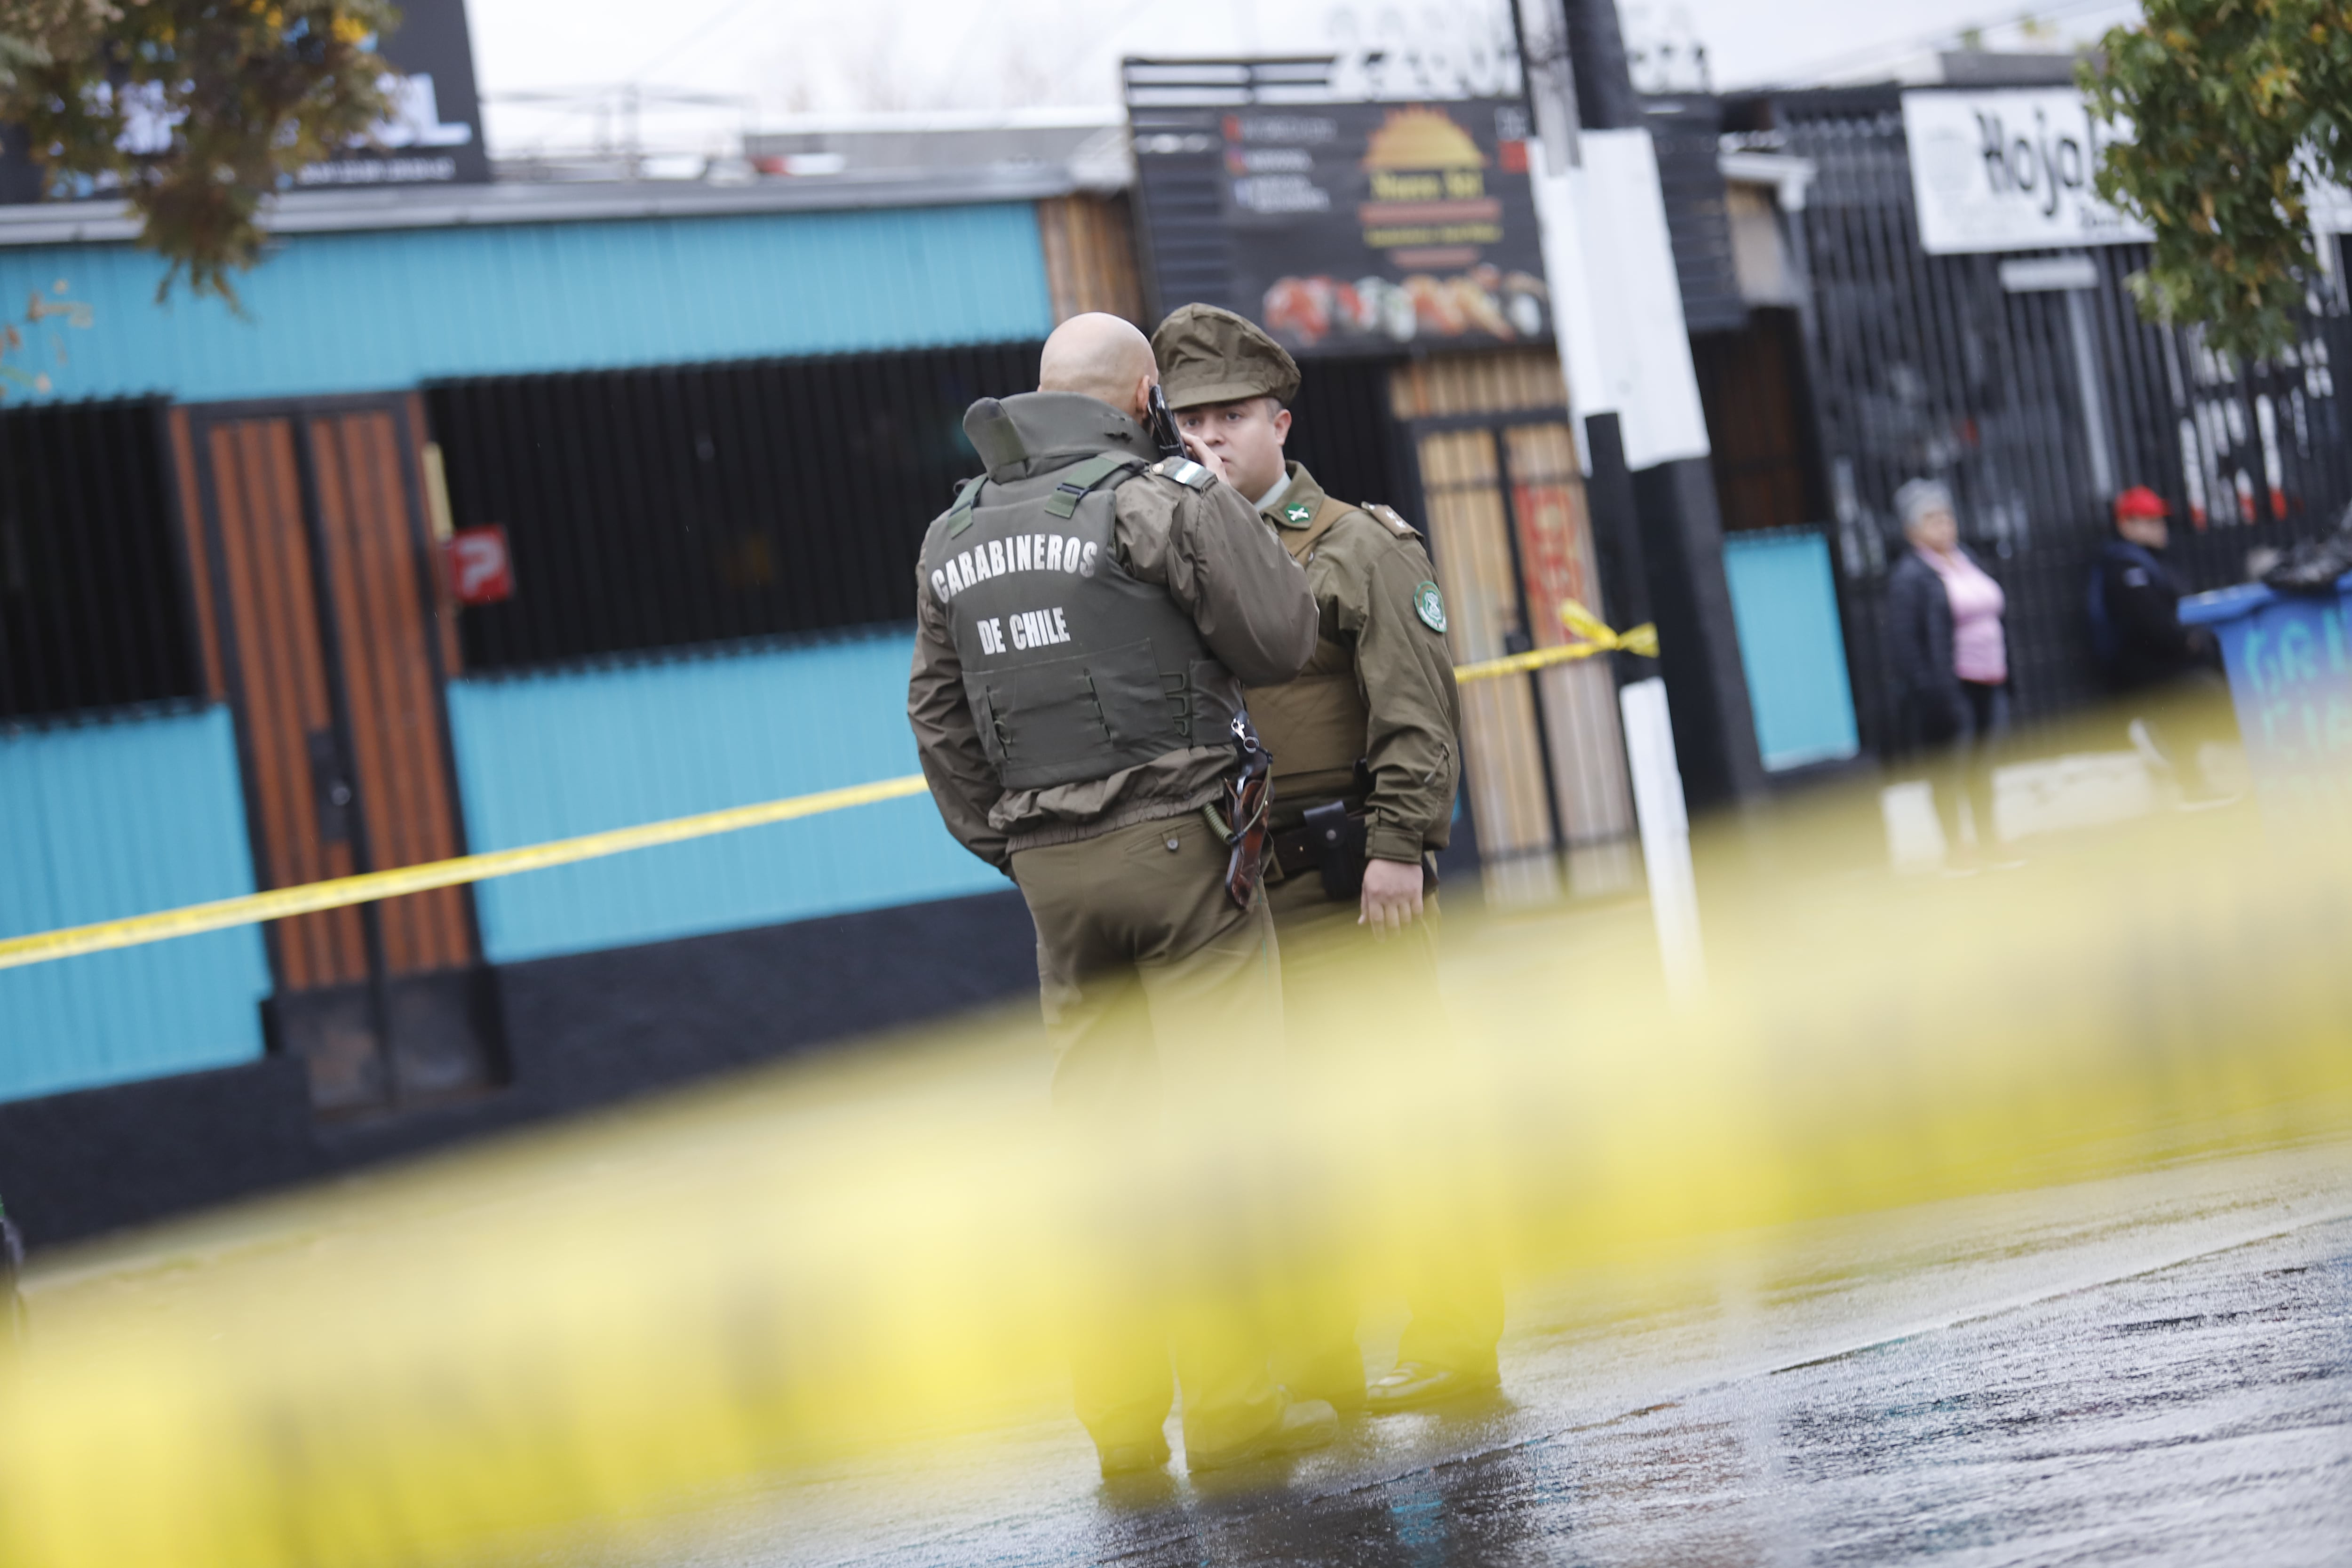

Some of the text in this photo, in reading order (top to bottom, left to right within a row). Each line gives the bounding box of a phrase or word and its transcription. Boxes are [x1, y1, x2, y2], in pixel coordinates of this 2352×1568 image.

[931, 533, 1098, 604] CARABINEROS
[977, 606, 1071, 655] DE CHILE
